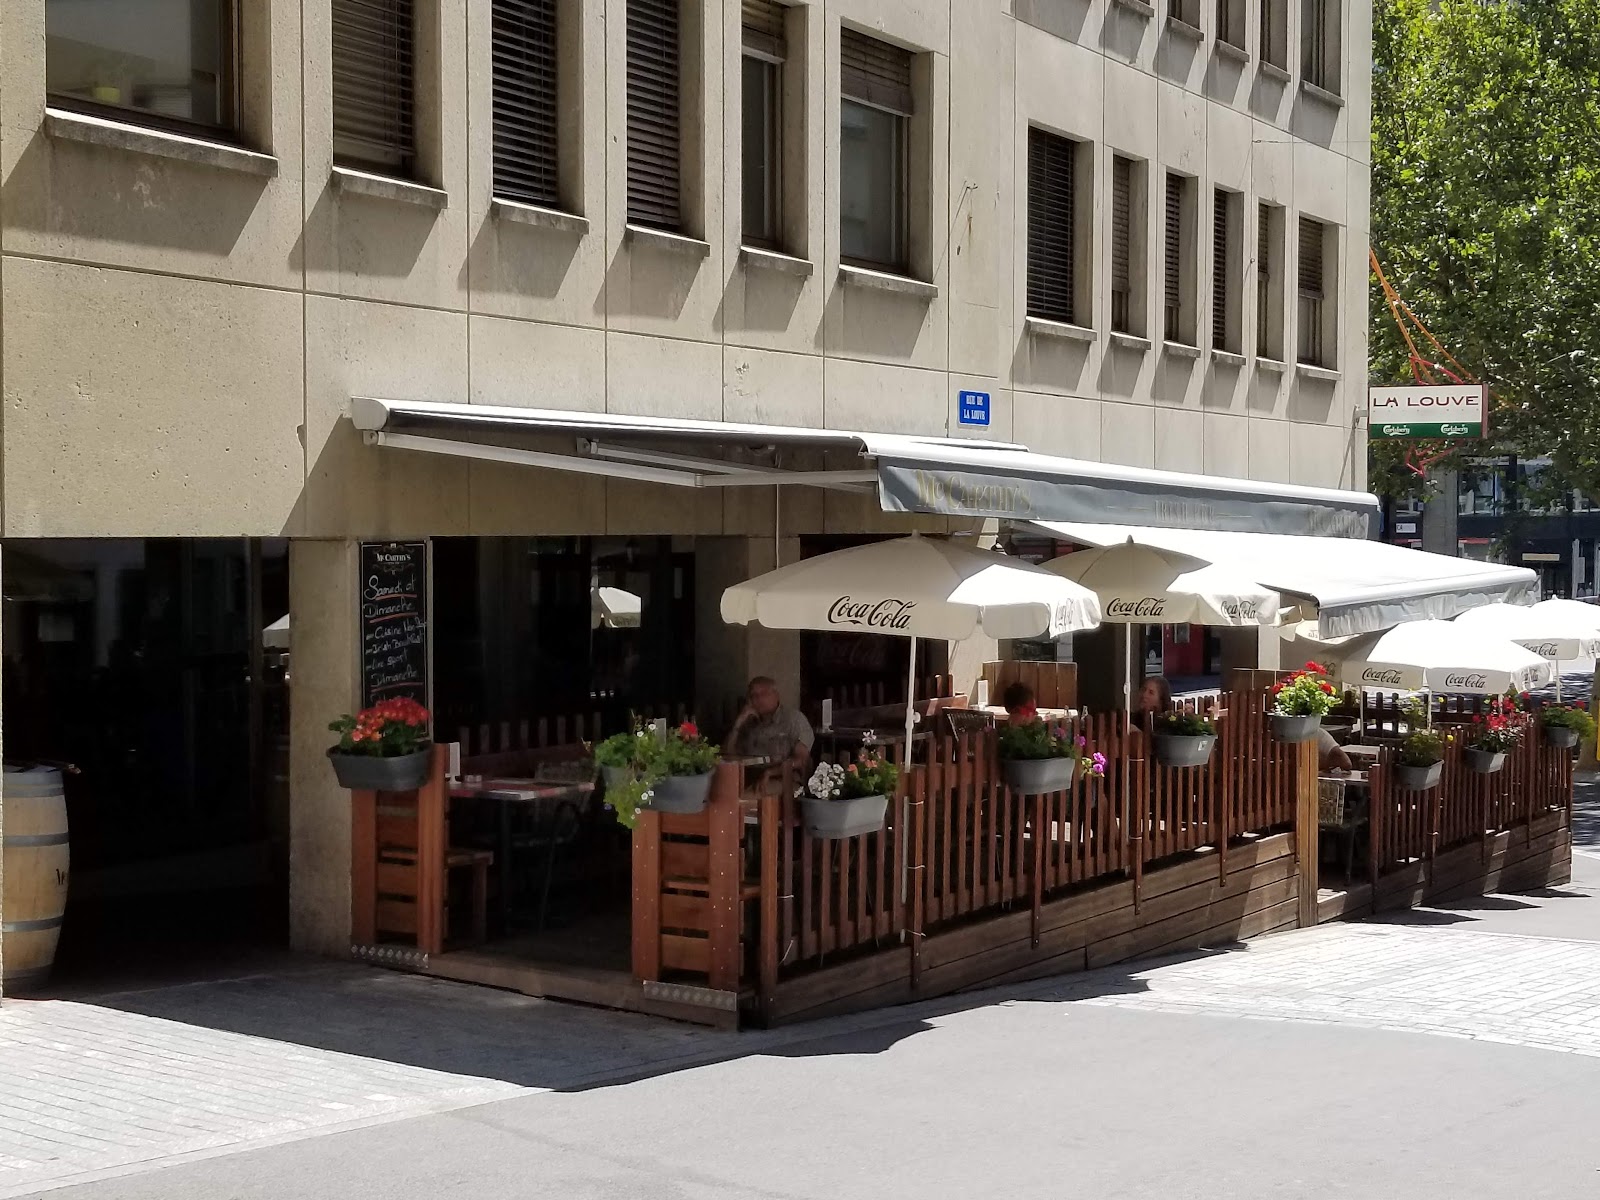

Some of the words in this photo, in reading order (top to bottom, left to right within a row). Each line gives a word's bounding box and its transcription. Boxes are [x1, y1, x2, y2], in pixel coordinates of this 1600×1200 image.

[1373, 397, 1398, 407] LA
[1407, 396, 1479, 407] LOUVE
[964, 408, 970, 419] LA
[1382, 425, 1411, 436] Carlsberg
[1440, 424, 1469, 436] Carlsberg
[363, 597, 415, 617] Dimanche
